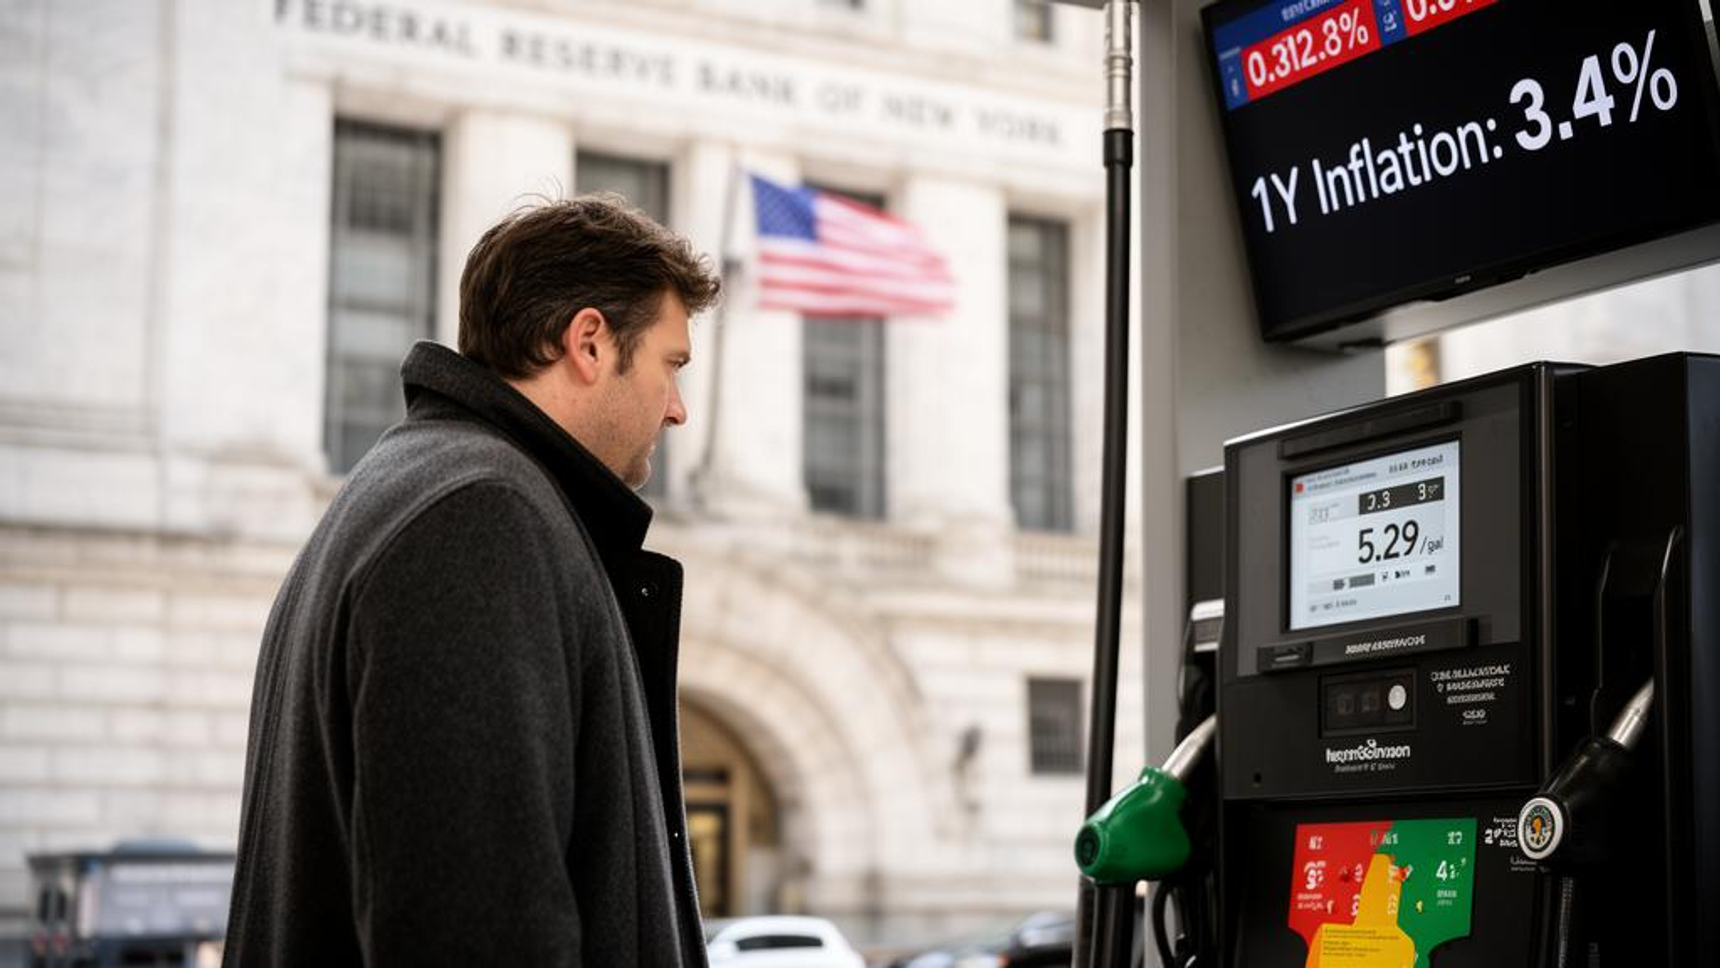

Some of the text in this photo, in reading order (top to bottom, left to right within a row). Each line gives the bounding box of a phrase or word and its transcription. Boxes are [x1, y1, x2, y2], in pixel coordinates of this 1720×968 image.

[273, 0, 479, 58] FEDERAL
[501, 30, 678, 89] RESERVE
[697, 60, 797, 108] BANK
[882, 92, 957, 132] NEW
[975, 105, 1066, 148] YORK
[1252, 29, 1678, 233] 1Y Inflation: 3.4%
